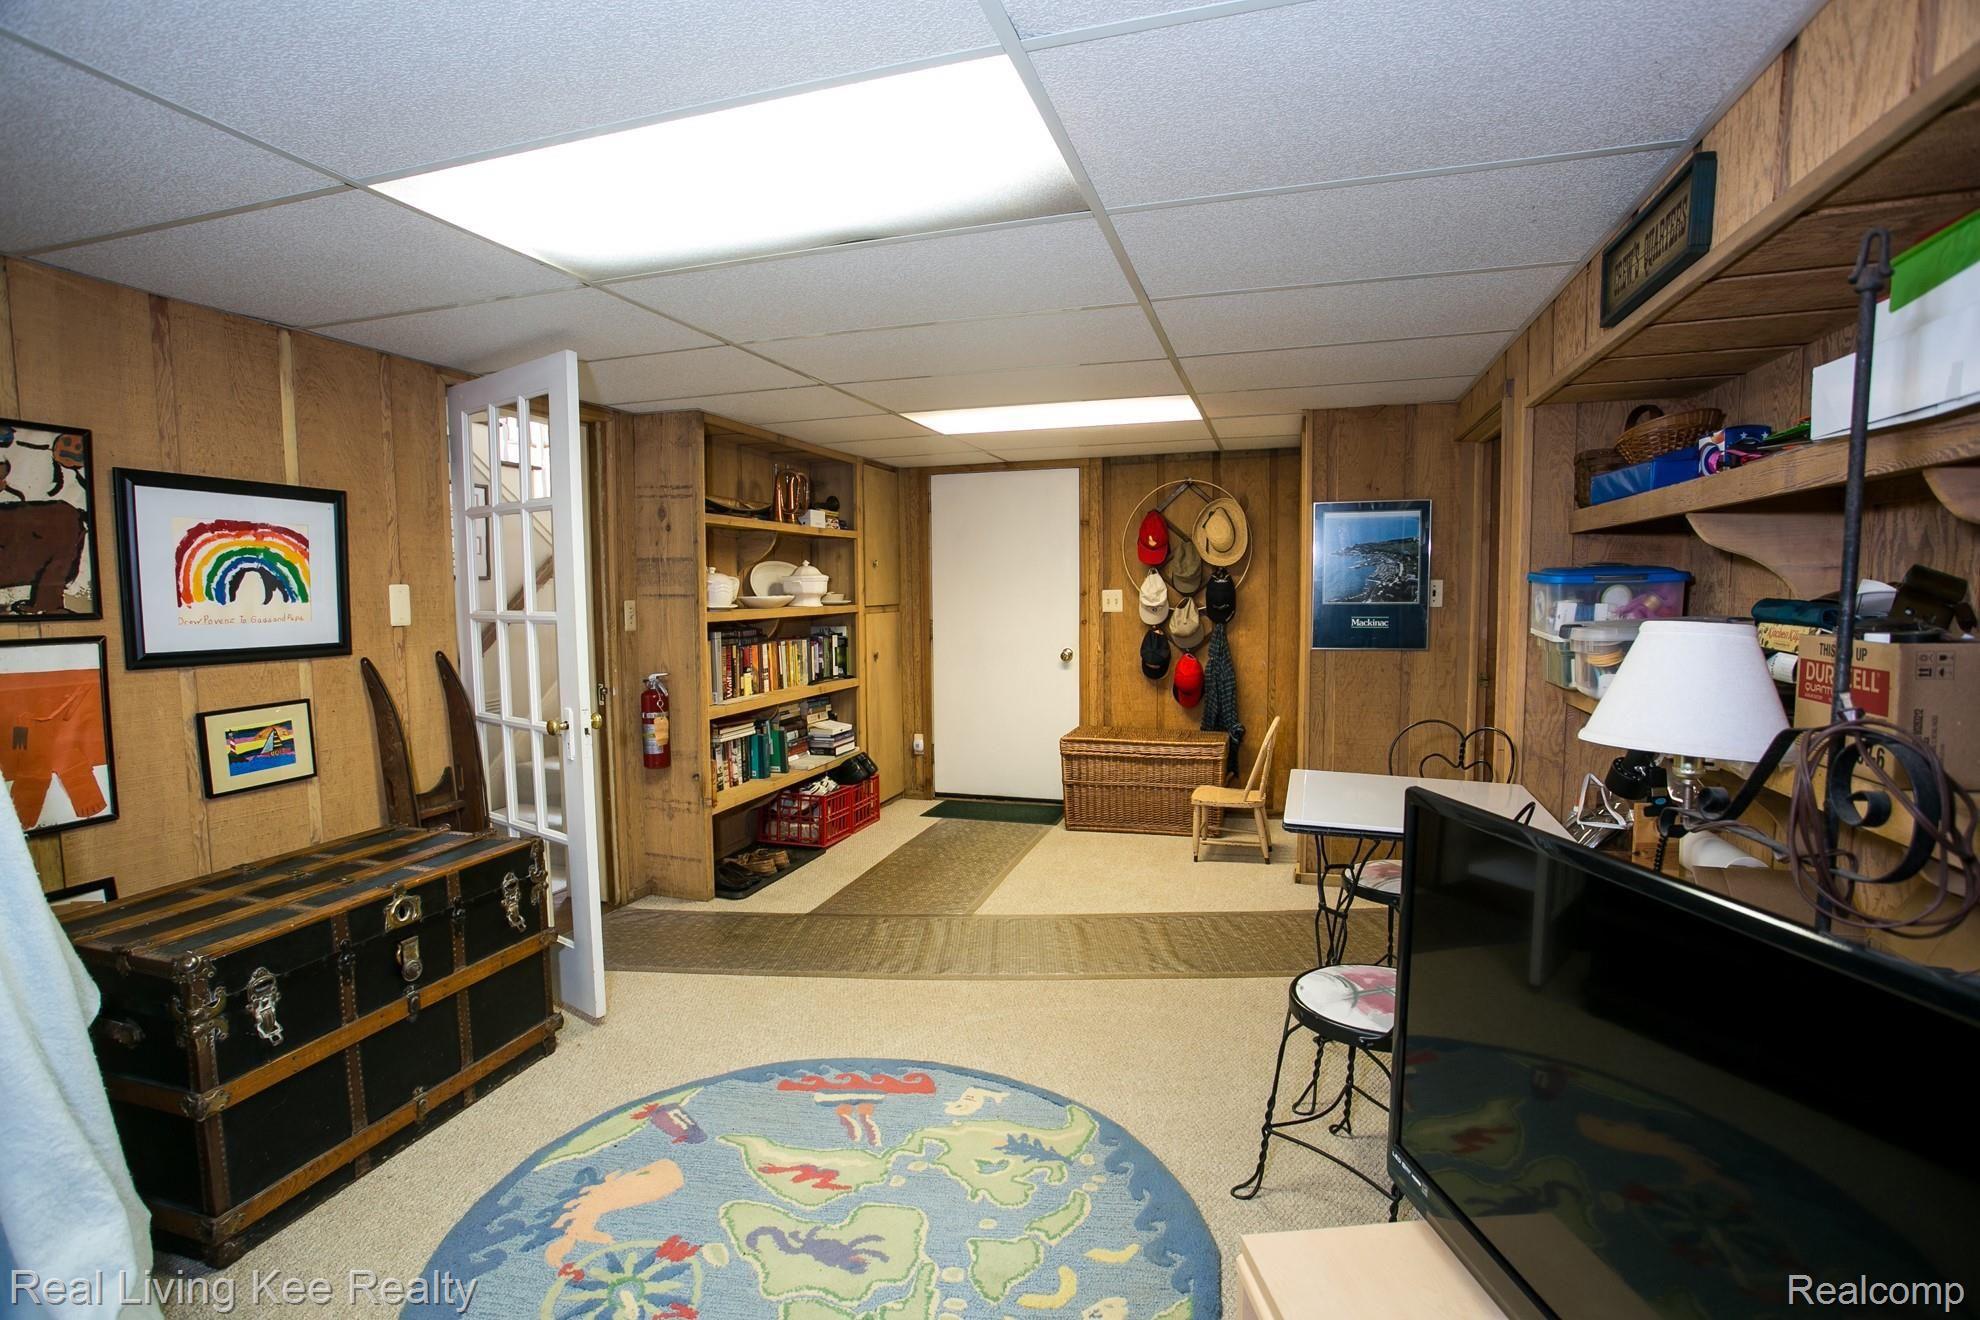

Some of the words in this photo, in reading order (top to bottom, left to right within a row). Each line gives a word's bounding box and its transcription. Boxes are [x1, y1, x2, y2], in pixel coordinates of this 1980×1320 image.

[1644, 193, 1688, 278] QUARTERS
[1351, 618, 1389, 627] Mackinac
[1819, 643, 1836, 657] THIS
[1856, 648, 1867, 661] UP
[1806, 662, 1880, 693] DURELL
